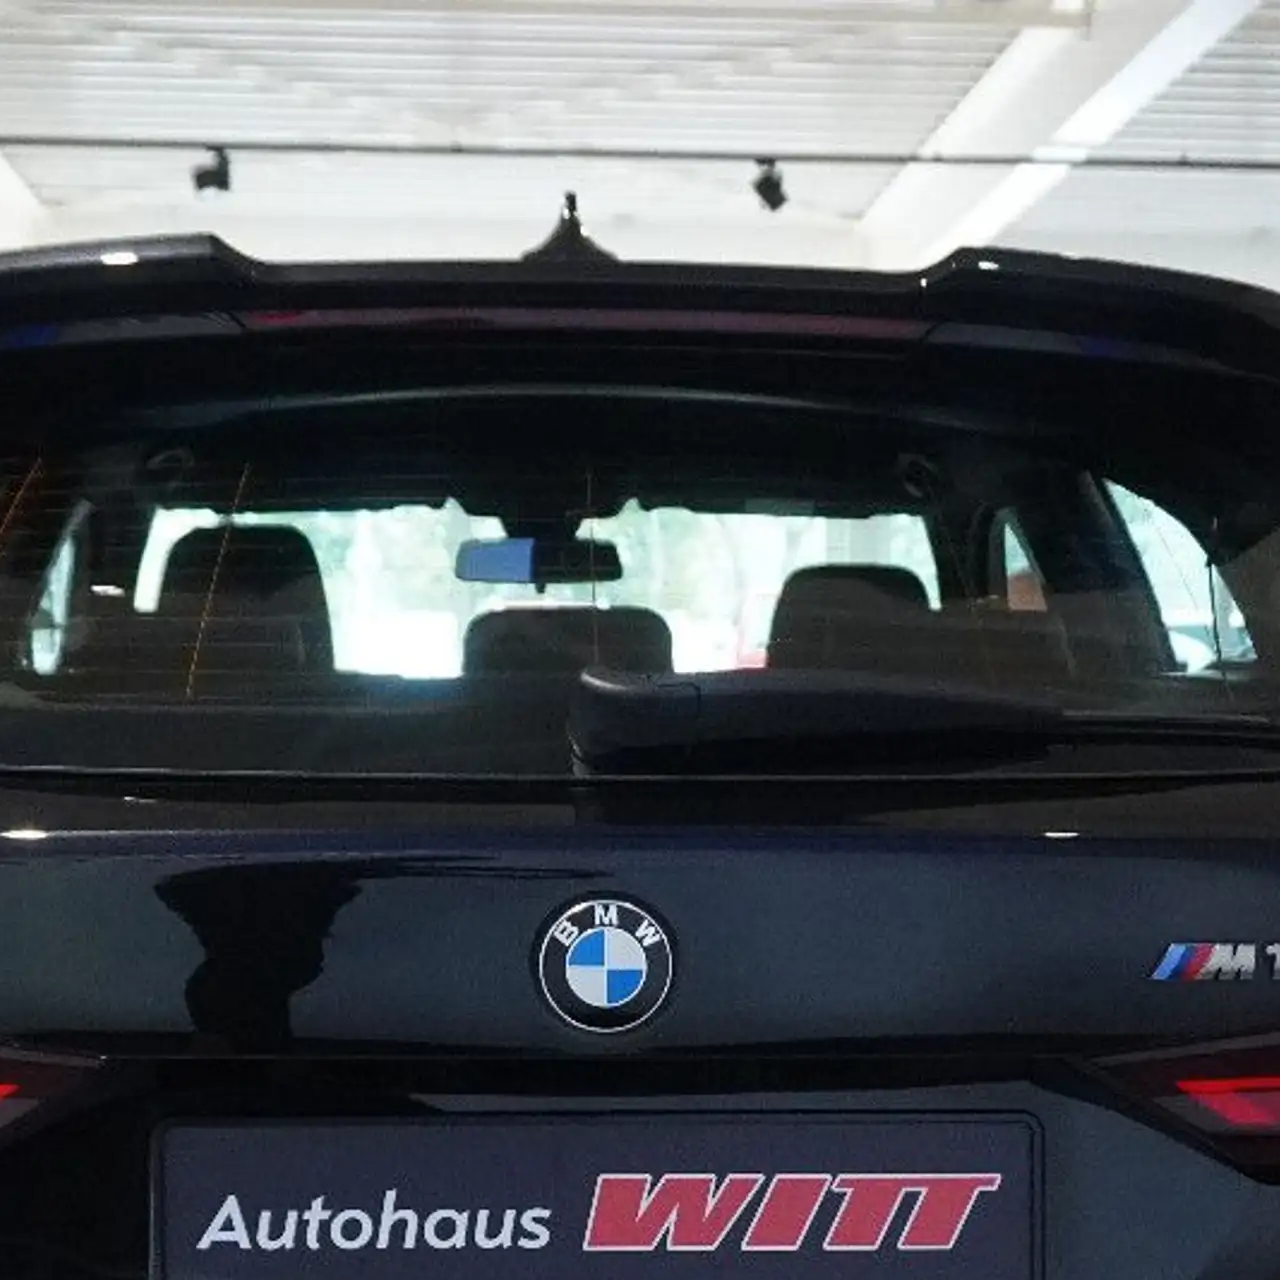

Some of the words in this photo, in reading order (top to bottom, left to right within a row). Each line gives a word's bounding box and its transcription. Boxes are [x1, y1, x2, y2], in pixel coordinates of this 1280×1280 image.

[553, 903, 661, 947] BMW
[196, 1189, 552, 1251] Autohaus
[582, 1173, 1001, 1251] WITT
